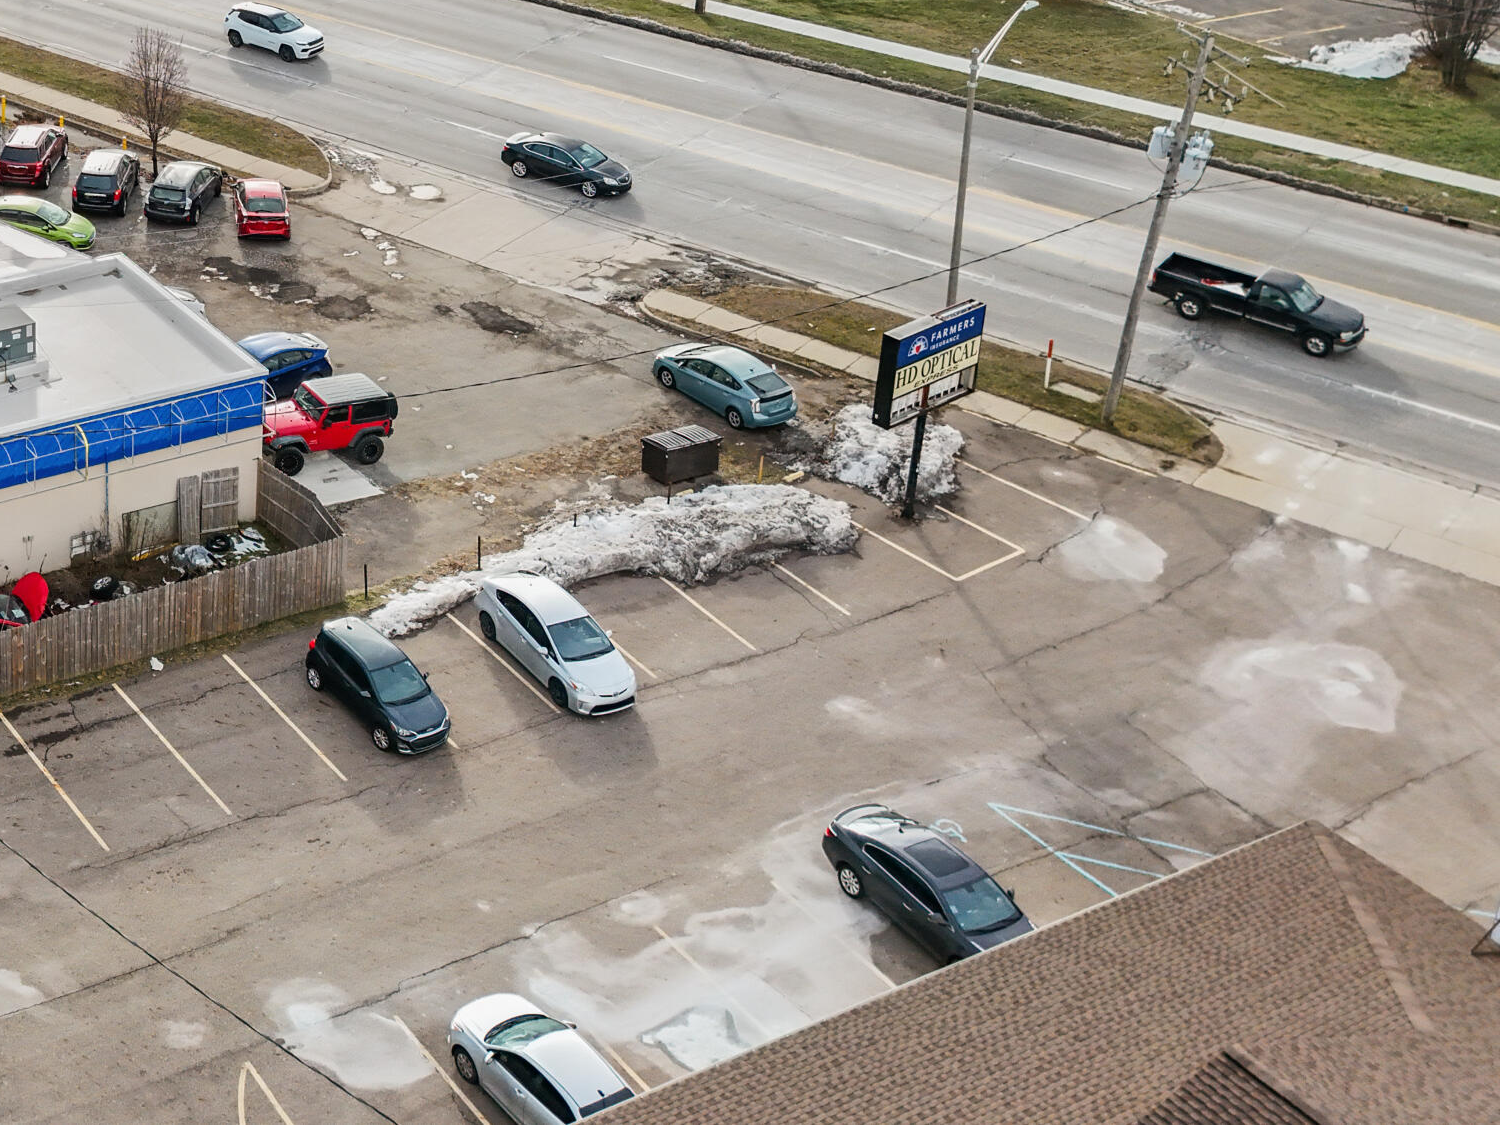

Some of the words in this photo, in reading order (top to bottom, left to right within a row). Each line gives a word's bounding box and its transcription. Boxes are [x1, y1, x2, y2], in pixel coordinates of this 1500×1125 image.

[930, 317, 975, 342] FARMERS
[930, 334, 960, 350] INSURANCE
[896, 365, 918, 389] HD
[921, 340, 978, 378] OPTICAL
[914, 365, 959, 387] EXPRESS
